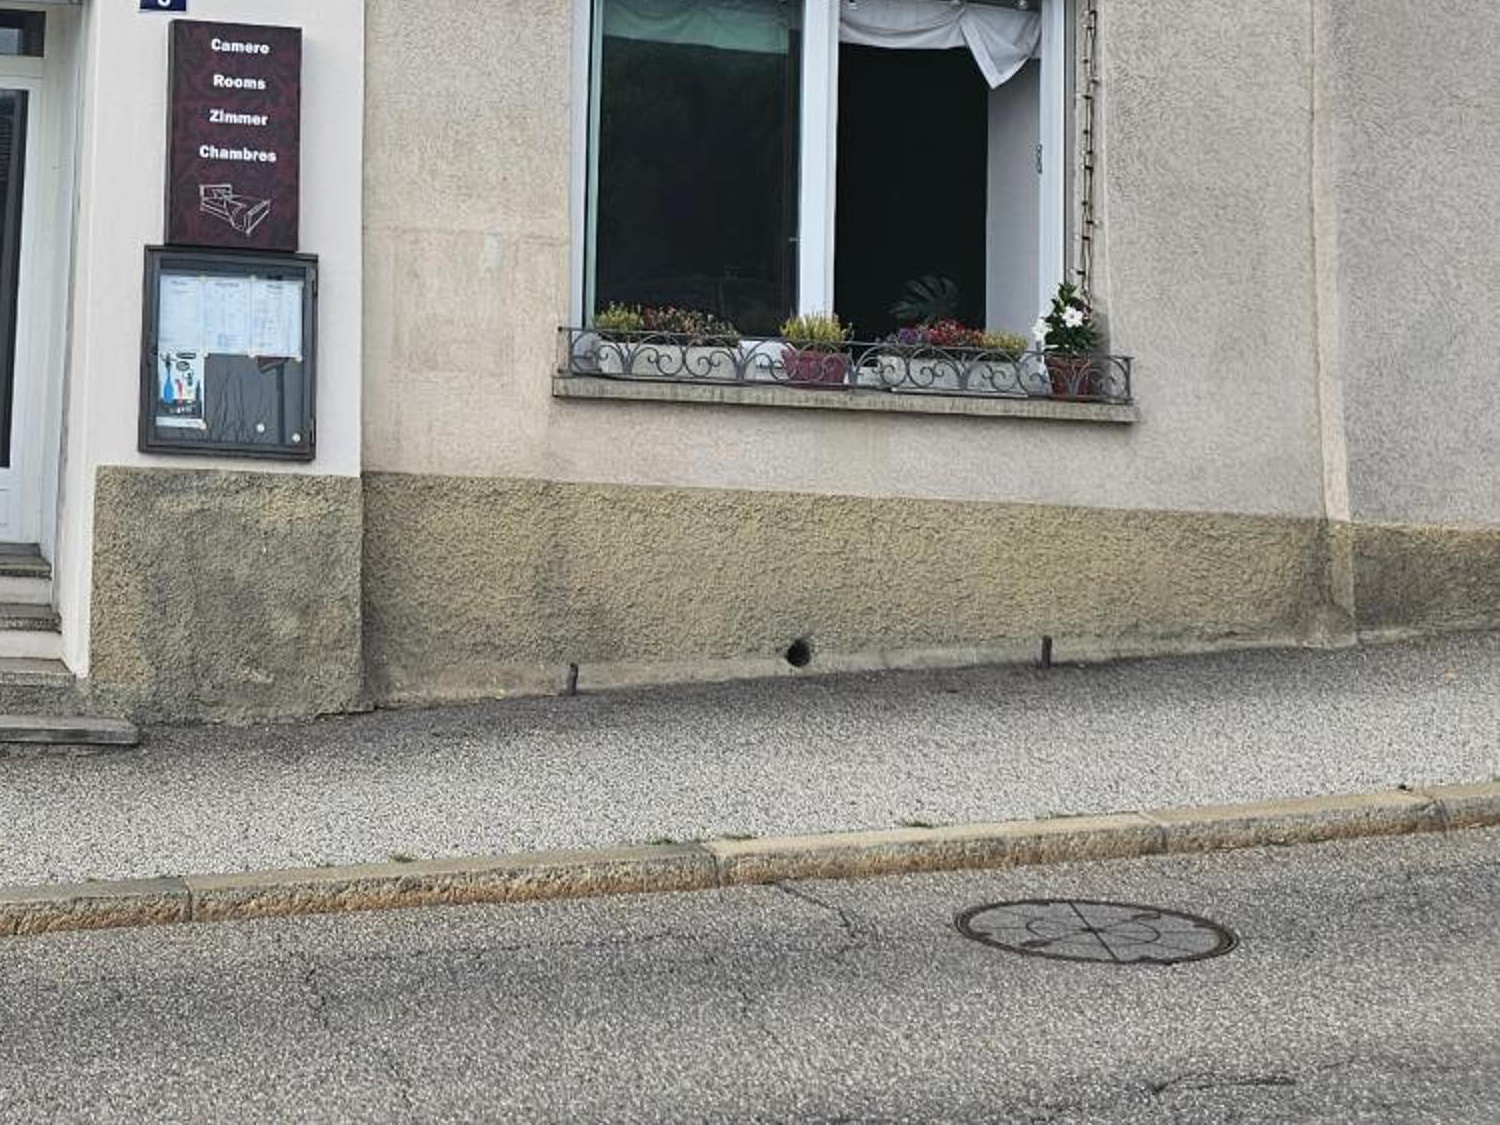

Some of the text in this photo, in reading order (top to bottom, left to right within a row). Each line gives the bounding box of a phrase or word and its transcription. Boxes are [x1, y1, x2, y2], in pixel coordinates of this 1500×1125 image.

[213, 74, 266, 90] Rooms
[209, 108, 269, 126] Zimmer
[199, 144, 277, 163] Chambres
